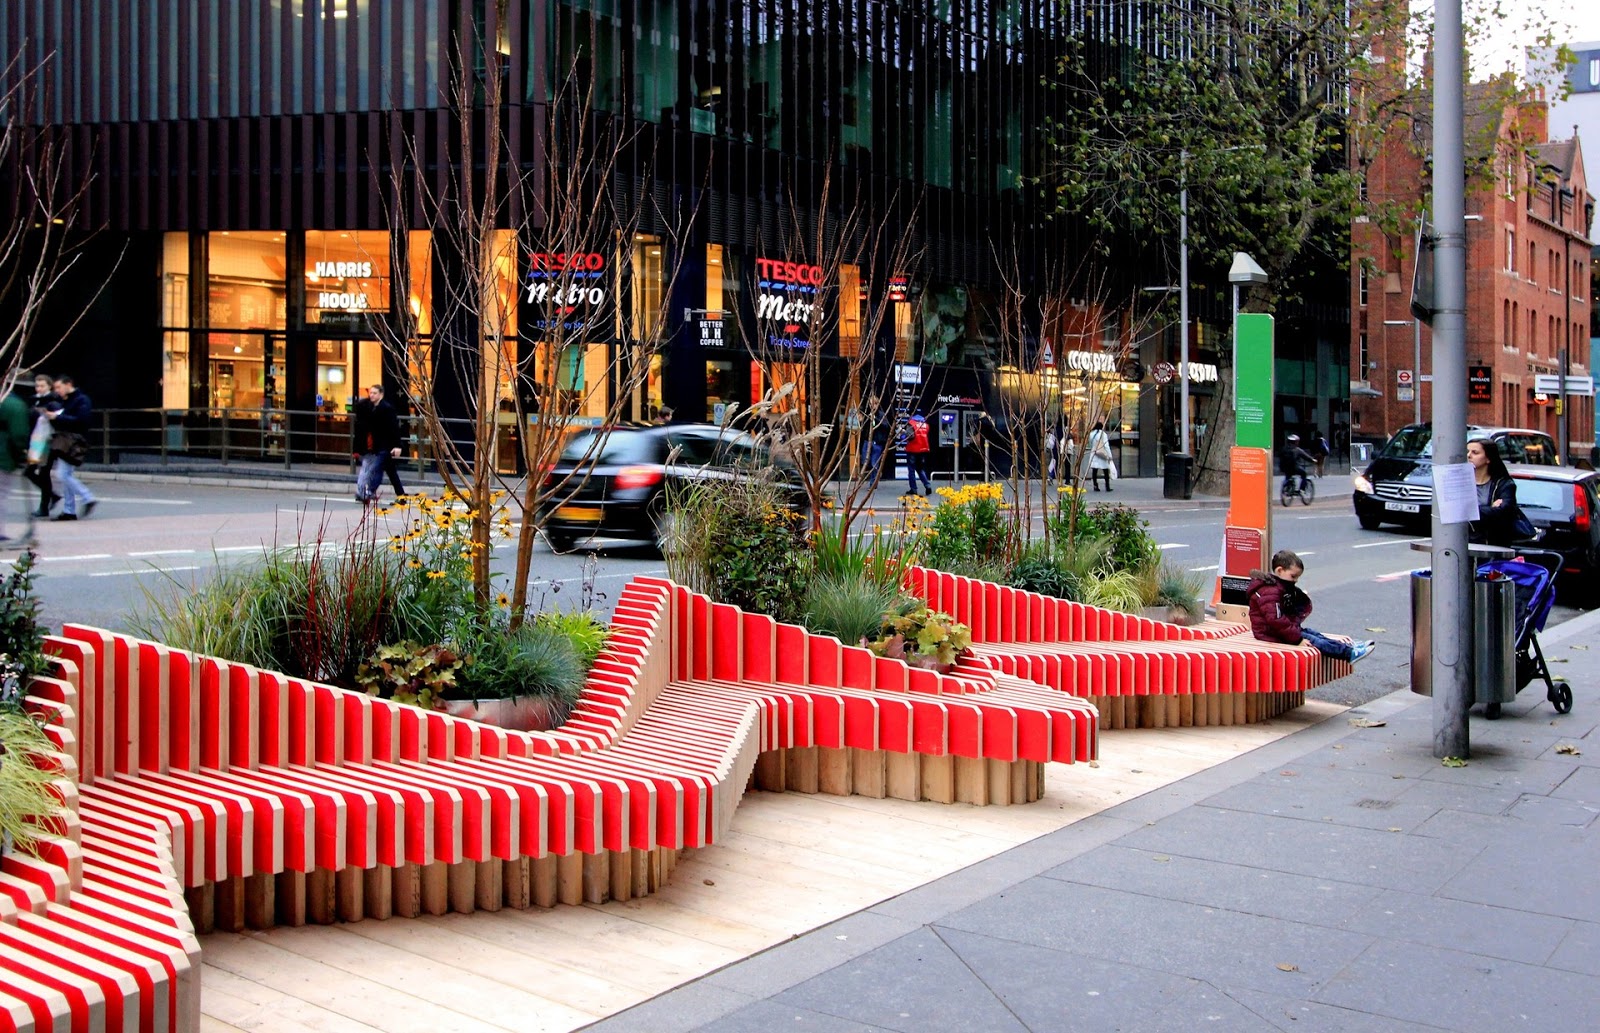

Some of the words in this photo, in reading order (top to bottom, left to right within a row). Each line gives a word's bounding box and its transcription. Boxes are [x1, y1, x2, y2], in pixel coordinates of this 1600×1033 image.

[528, 252, 604, 270] TESCO
[315, 262, 372, 278] HARRIS
[756, 258, 825, 285] TESCO
[319, 292, 368, 308] HOOLE
[700, 321, 723, 329] BETTER
[700, 338, 724, 346] COFFEE
[1068, 350, 1116, 374] COSTA
[937, 394, 948, 403] Free
[948, 394, 960, 403] Cash
